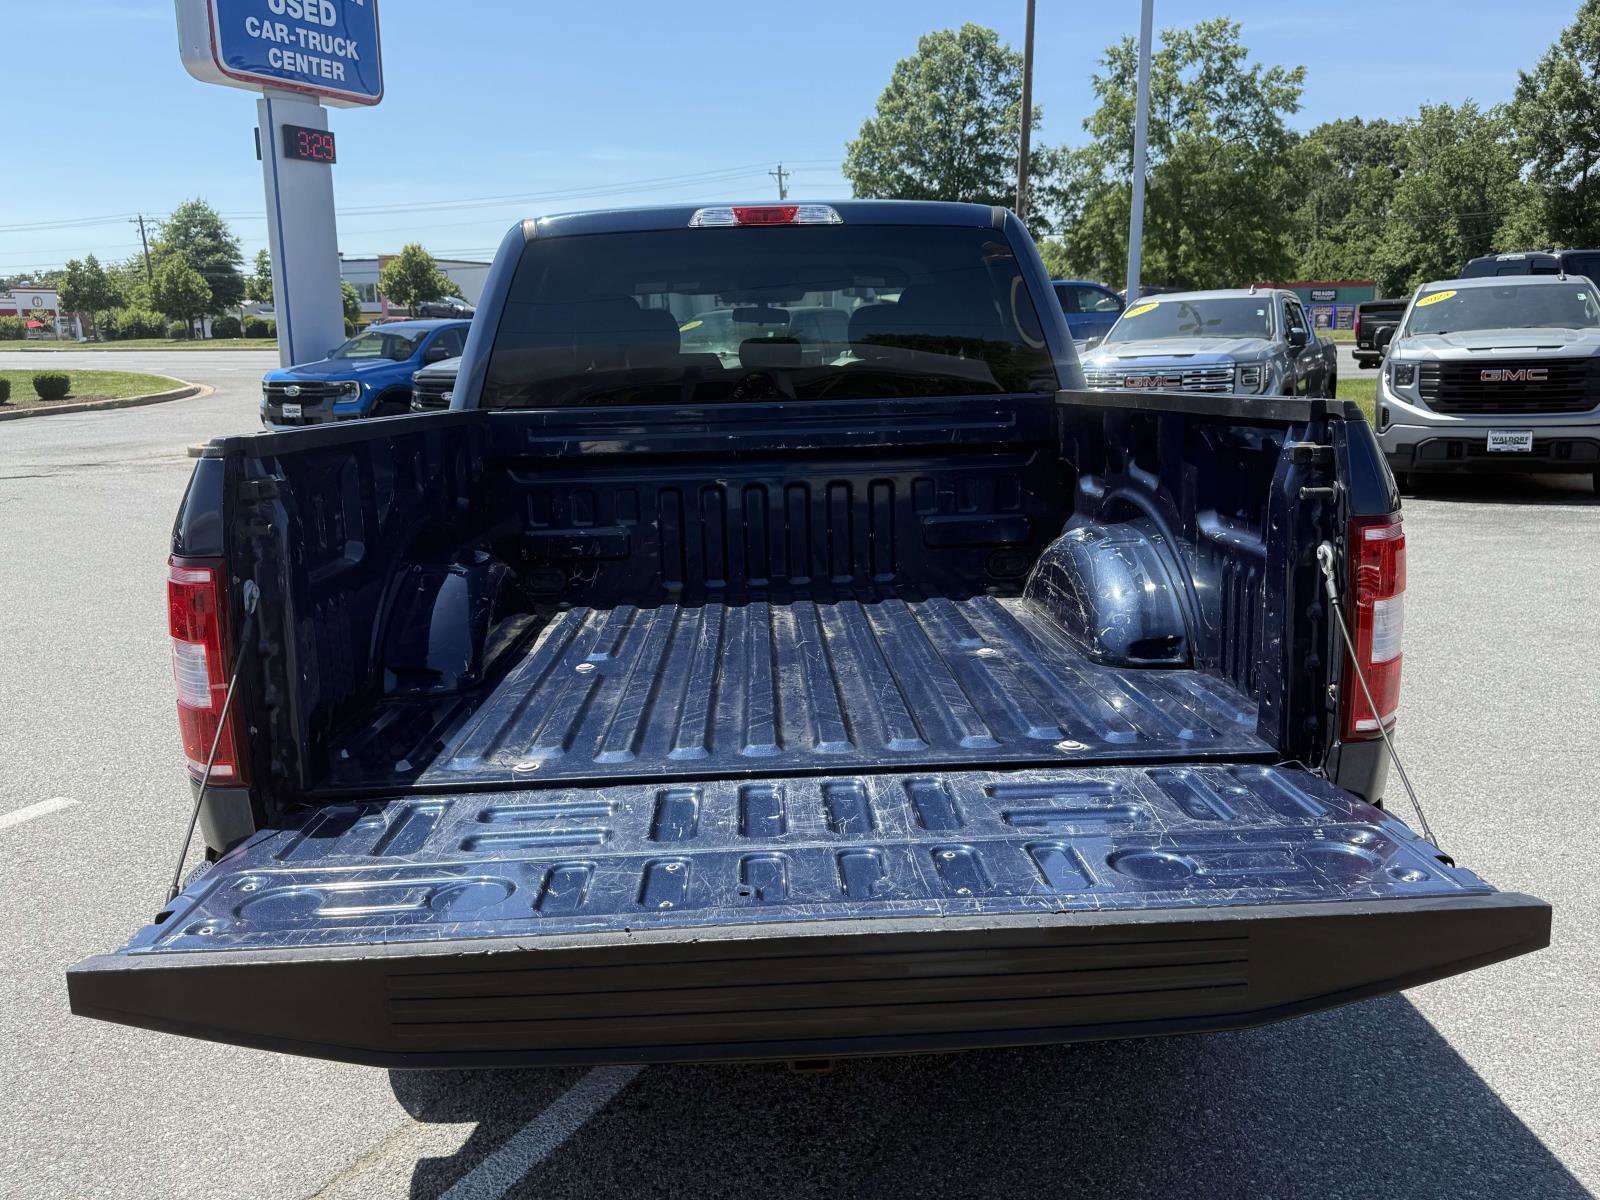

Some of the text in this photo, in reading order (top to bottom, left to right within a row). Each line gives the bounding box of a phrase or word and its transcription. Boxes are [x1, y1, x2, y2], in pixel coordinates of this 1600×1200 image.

[267, 0, 337, 27] USED
[245, 16, 359, 61] CAR-TRUCK
[268, 47, 345, 82] CENTER
[297, 131, 334, 159] 3:29
[1125, 376, 1181, 387] GMC
[1480, 368, 1549, 381] GMC
